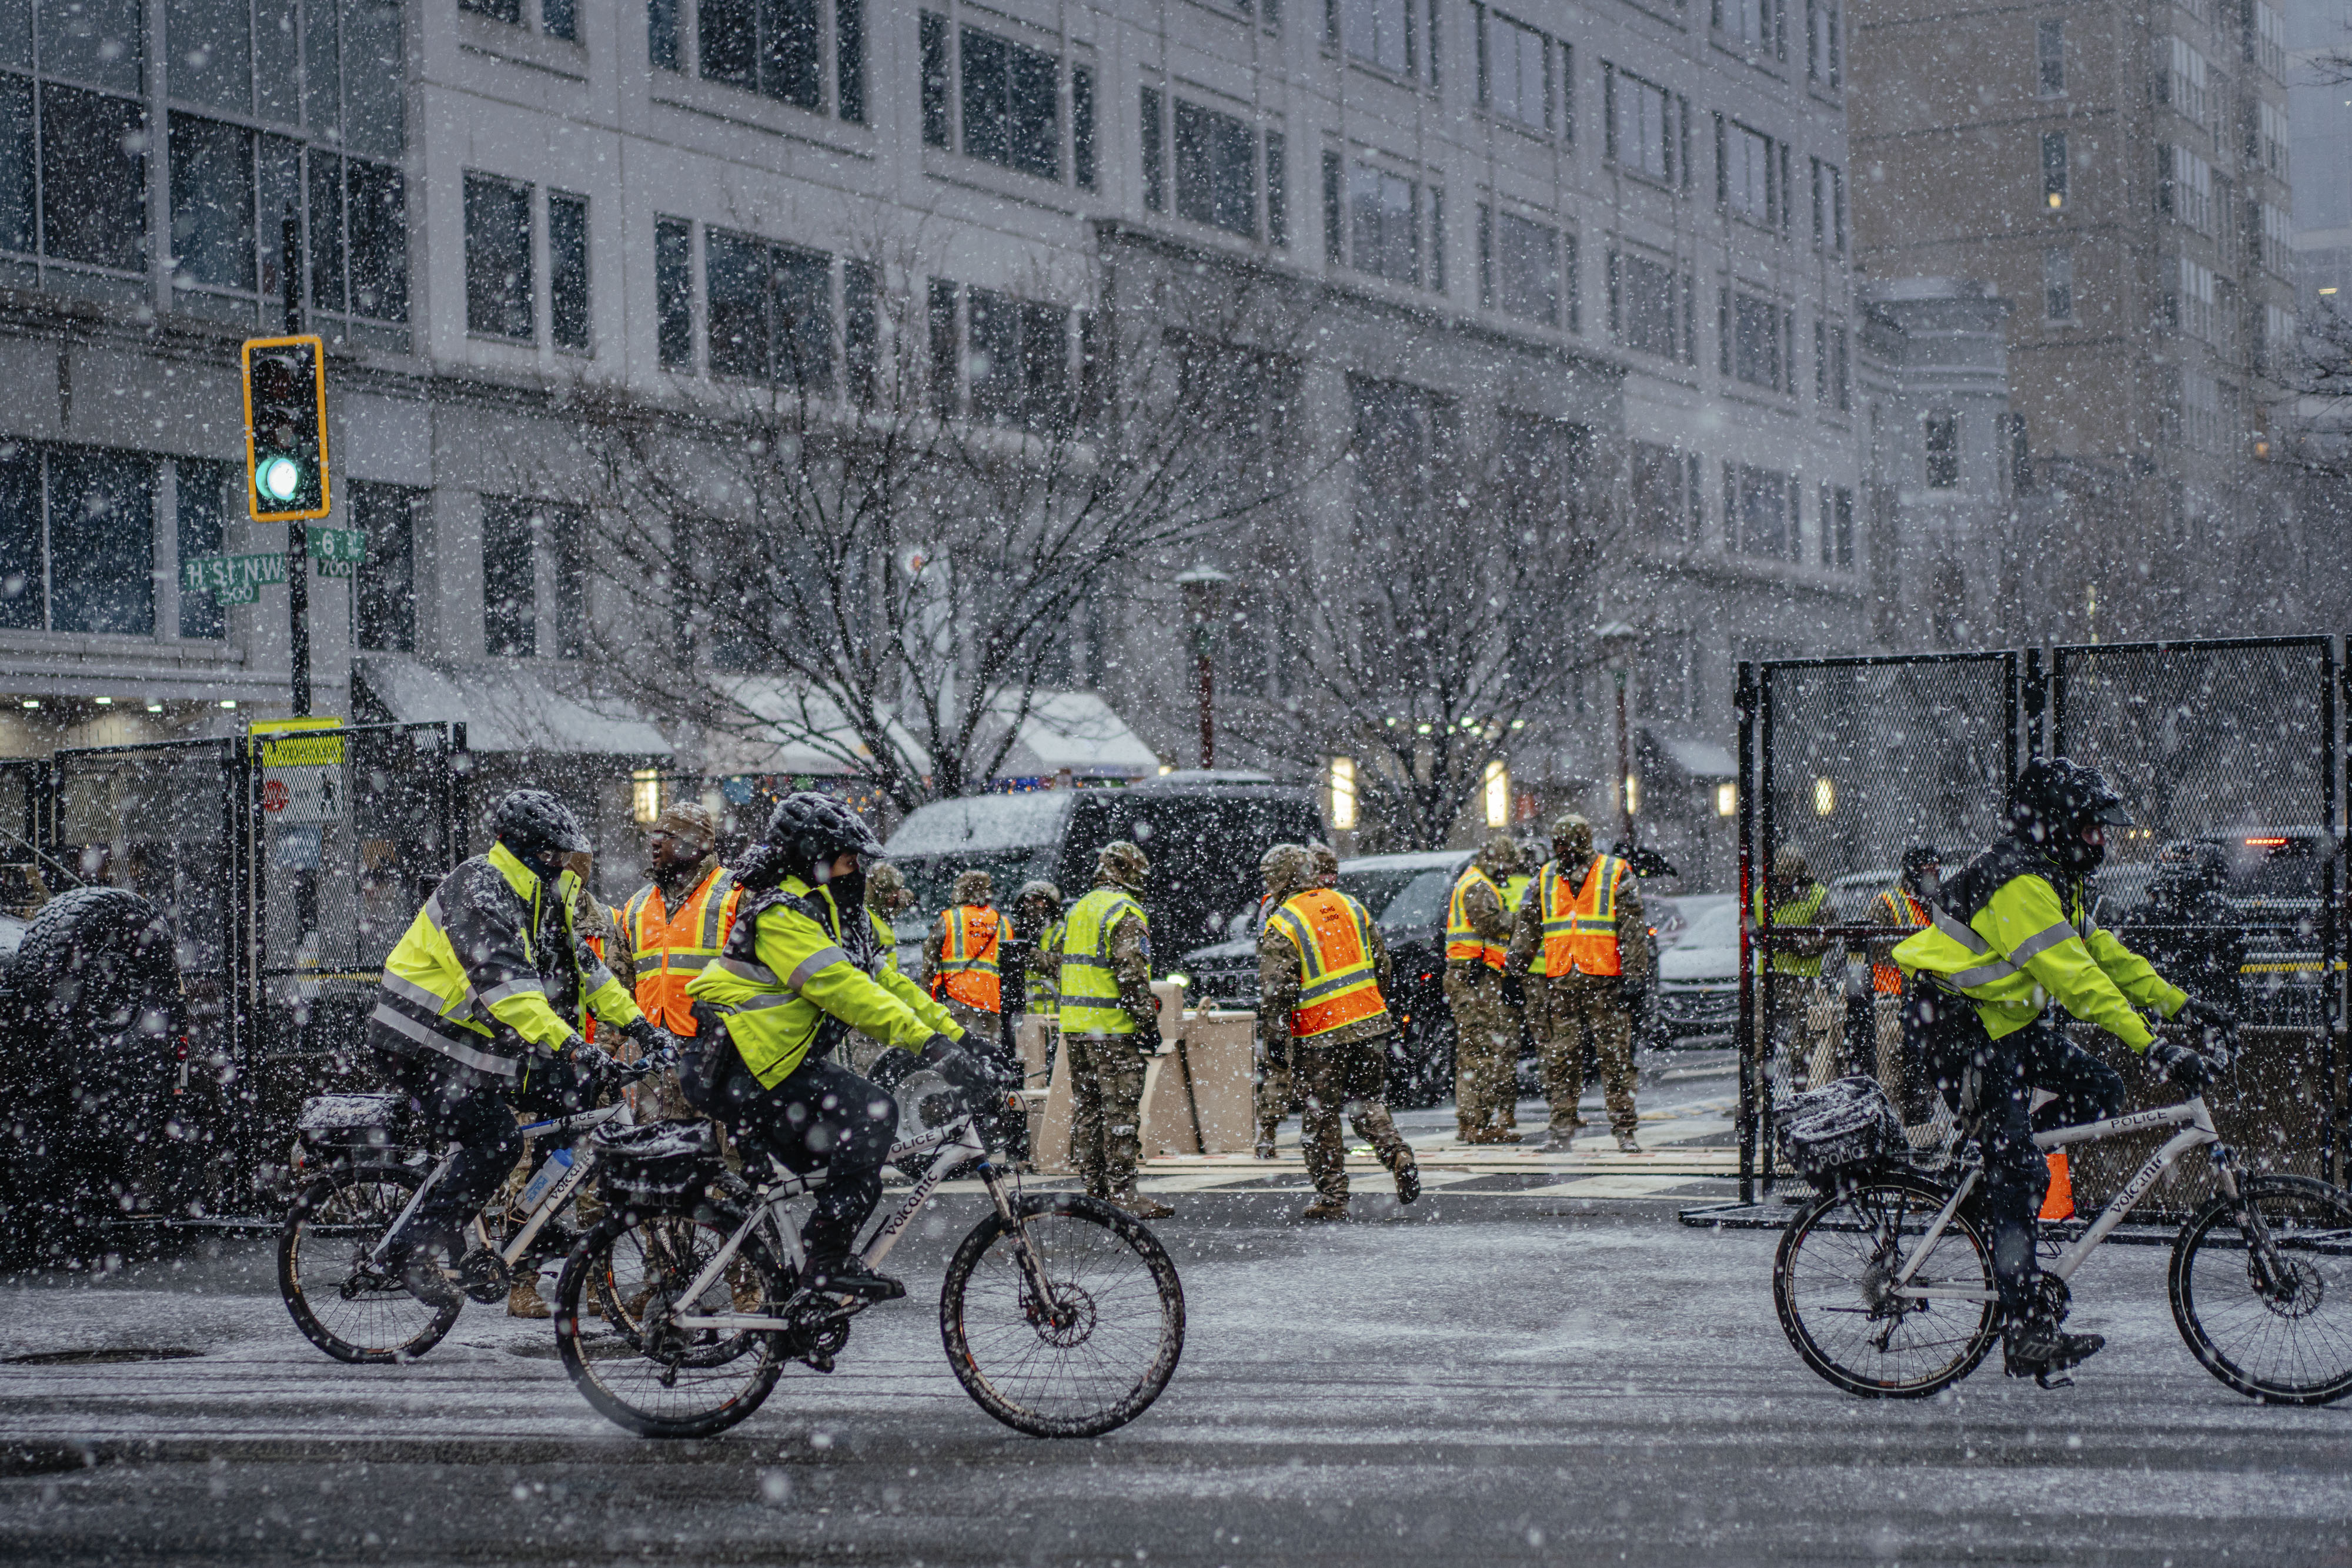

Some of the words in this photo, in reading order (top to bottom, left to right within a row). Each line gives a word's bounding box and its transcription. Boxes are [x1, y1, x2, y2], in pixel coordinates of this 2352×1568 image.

[322, 531, 335, 555] 6
[189, 563, 203, 586] H
[213, 559, 235, 584] St
[245, 557, 282, 582] NW
[321, 560, 349, 576] 700
[2111, 1112, 2167, 1129] POLICE
[891, 1134, 935, 1153] OLICE
[1819, 1144, 1868, 1169] POLICE
[527, 1177, 548, 1203] POLICE
[630, 1191, 681, 1207] POLICE
[885, 1171, 937, 1235] volcanic
[1899, 1375, 1927, 1386] SINGLE
